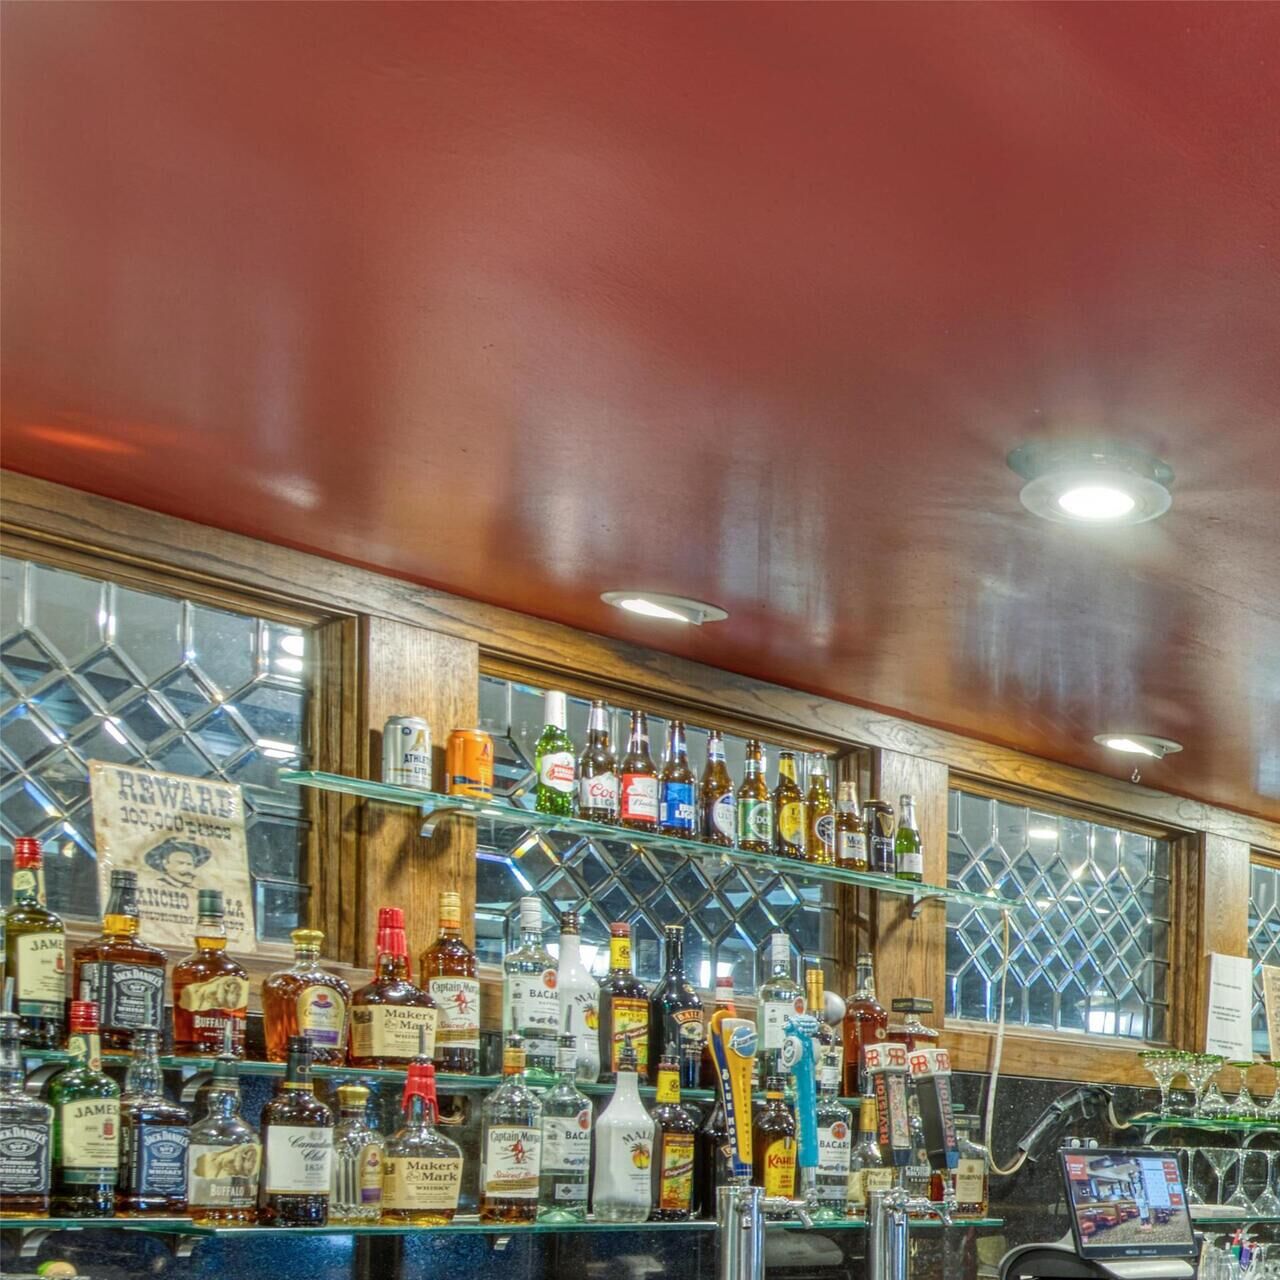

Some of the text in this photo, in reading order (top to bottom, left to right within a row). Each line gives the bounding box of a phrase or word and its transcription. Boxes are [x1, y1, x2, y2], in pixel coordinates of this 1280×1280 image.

[117, 769, 234, 818] REWARD
[137, 887, 190, 911] ANCHO
[113, 968, 133, 983] JACK
[431, 981, 462, 994] Captain
[385, 1008, 435, 1021] Maker's
[874, 1073, 890, 1146] REVISION
[938, 1078, 957, 1148] REVISION
[490, 1129, 520, 1143] Captain
[406, 1160, 459, 1172] Maker's
[421, 1171, 458, 1182] Mark
